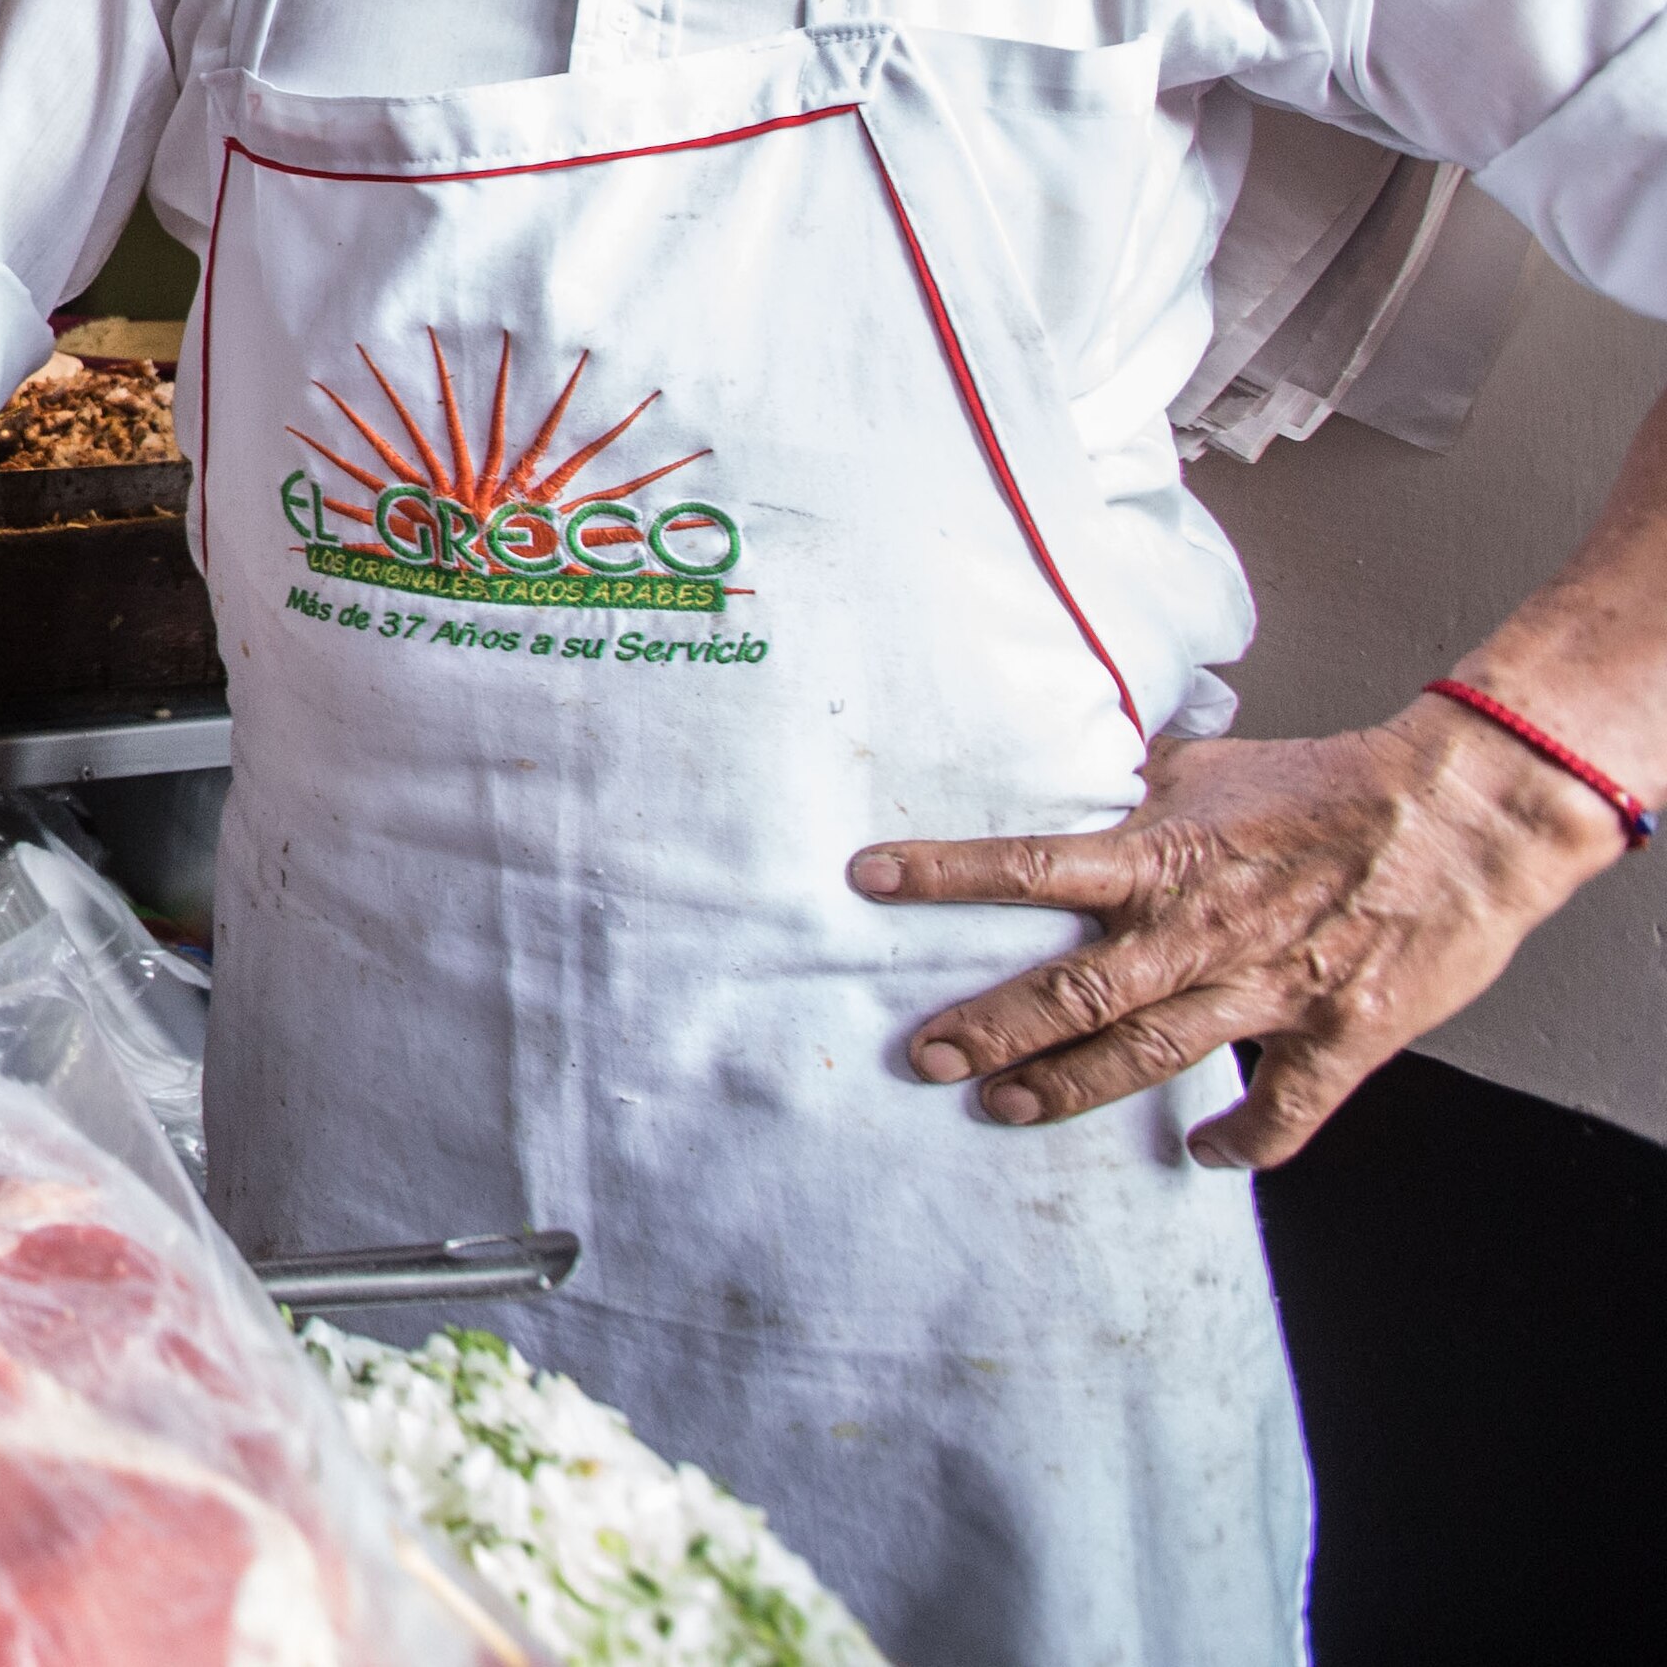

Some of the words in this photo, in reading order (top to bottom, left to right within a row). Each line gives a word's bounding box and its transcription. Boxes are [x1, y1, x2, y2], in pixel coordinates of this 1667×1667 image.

[281, 470, 341, 543] EL
[375, 484, 742, 576] GRECO
[310, 548, 347, 572] LOS
[493, 580, 584, 602] TACOS
[593, 583, 715, 606] ARABES
[285, 585, 333, 622] Más
[338, 603, 373, 631] de
[378, 611, 427, 638] 37
[429, 620, 522, 652] Años
[530, 633, 555, 656] a
[560, 636, 607, 660] su
[614, 631, 771, 665] Servicio
